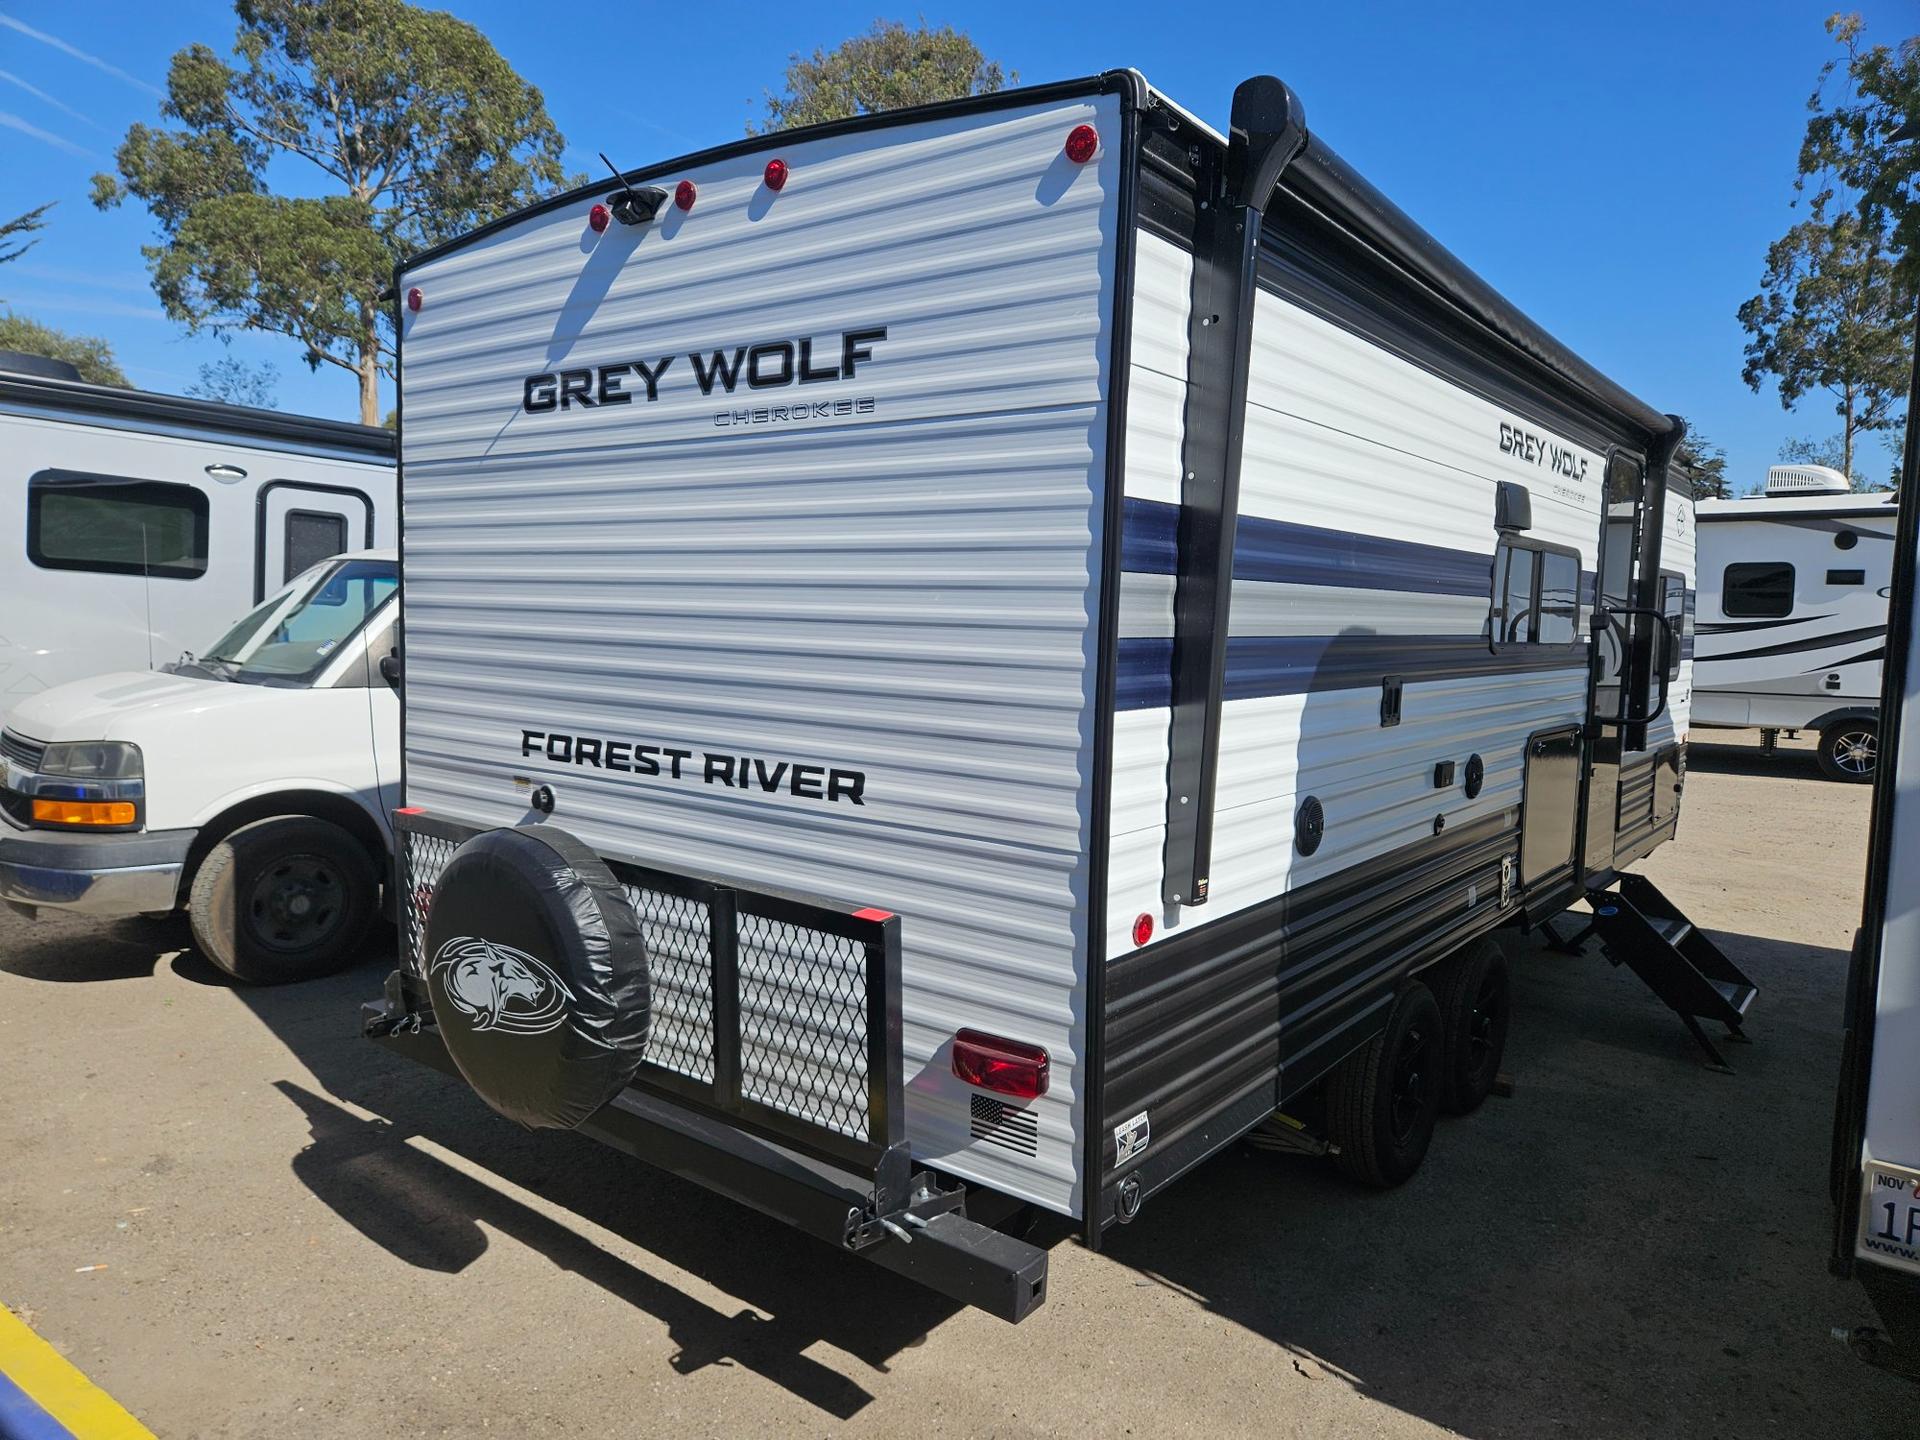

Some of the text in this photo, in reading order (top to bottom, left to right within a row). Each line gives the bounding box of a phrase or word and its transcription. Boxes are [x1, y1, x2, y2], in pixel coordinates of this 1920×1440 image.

[523, 326, 887, 415] GREY WOLF
[713, 396, 875, 427] CHEROKEE
[1499, 422, 1588, 482] GREY WOLF
[521, 729, 866, 806] FOREST RIVER
[1878, 1174, 1905, 1190] NOV
